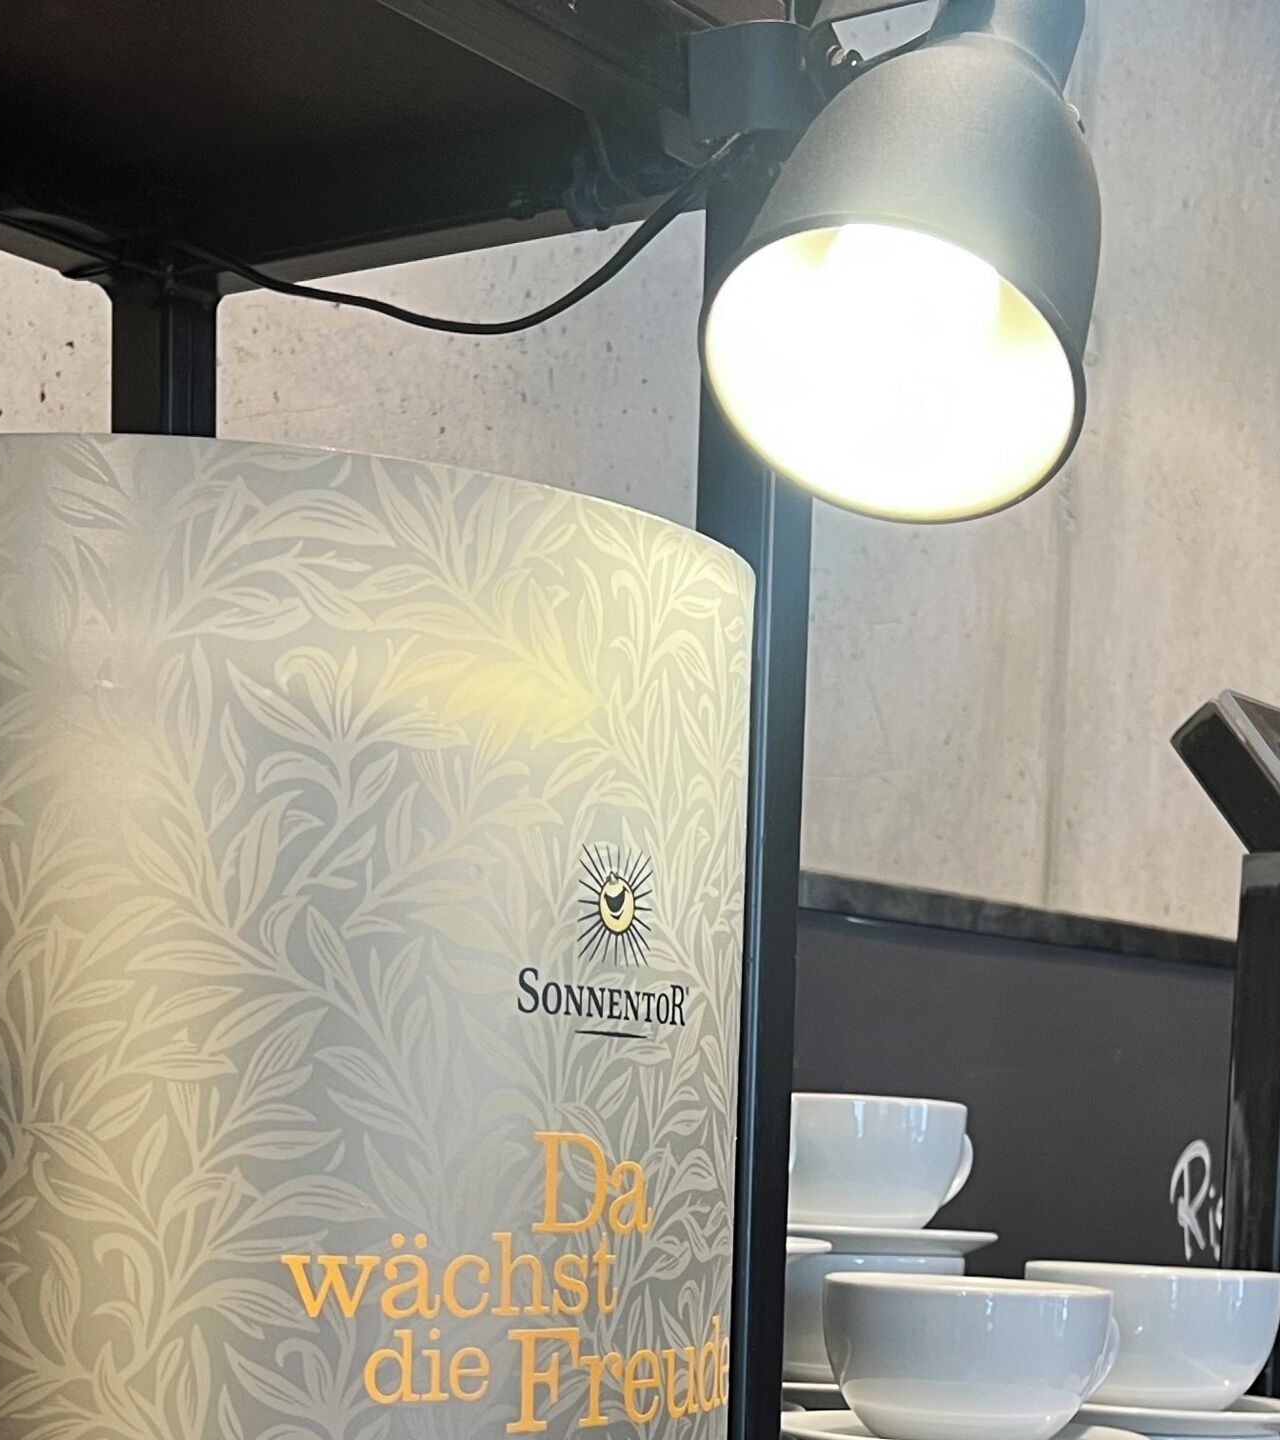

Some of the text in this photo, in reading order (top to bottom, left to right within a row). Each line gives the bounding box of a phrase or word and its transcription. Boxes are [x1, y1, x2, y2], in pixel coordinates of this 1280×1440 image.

[517, 966, 689, 1028] SONNENTOR
[531, 1130, 654, 1236] Da
[281, 1231, 618, 1320] wächst
[363, 1327, 490, 1405] die
